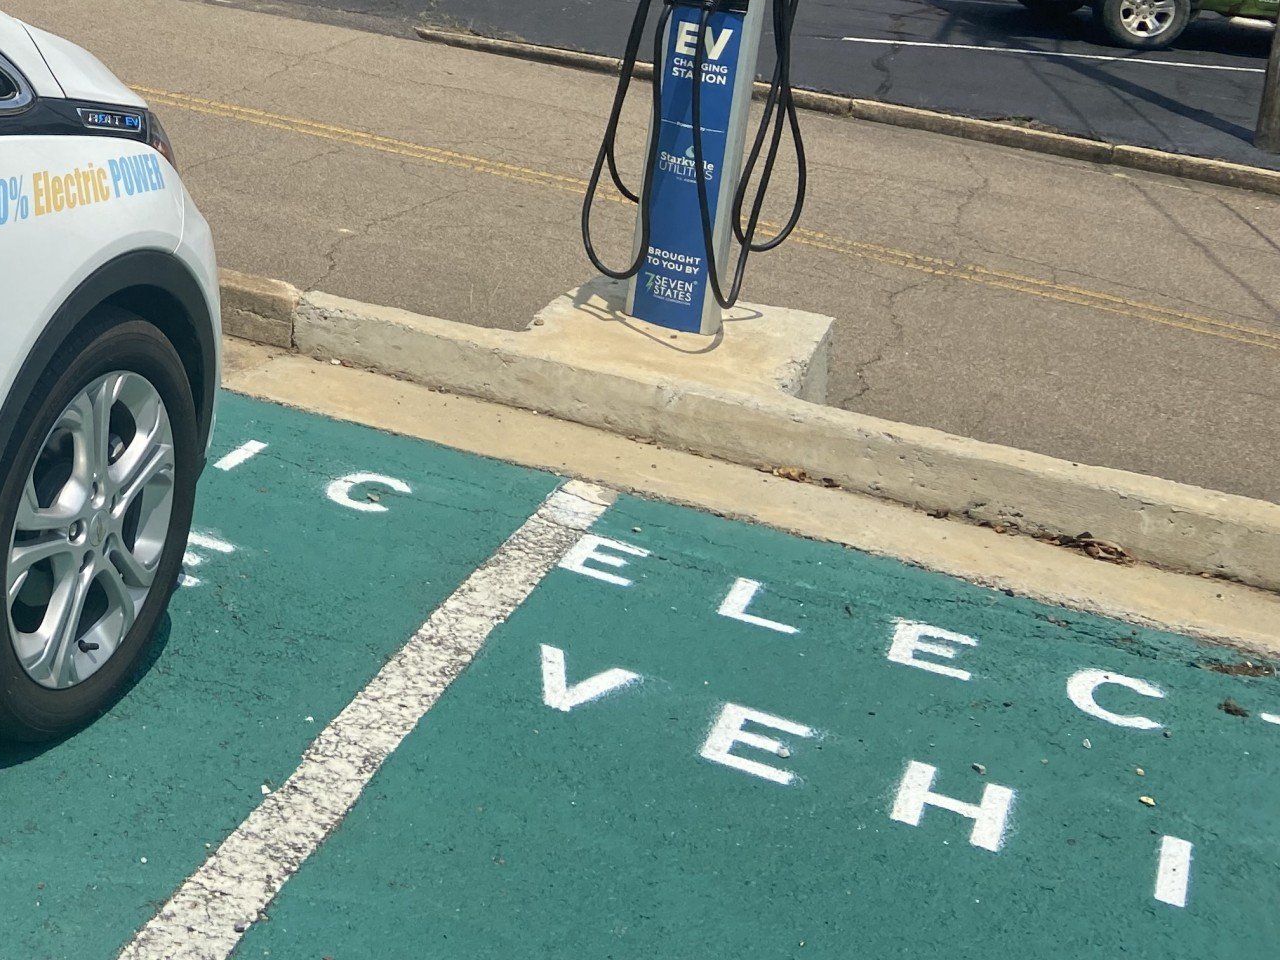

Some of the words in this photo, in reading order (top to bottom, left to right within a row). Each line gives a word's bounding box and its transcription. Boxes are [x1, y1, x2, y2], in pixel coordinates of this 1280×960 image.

[675, 21, 733, 61] EV
[673, 57, 728, 74] CHAGING
[671, 66, 727, 85] STAION
[125, 116, 138, 126] EV
[659, 160, 714, 181] UTILITIS
[660, 151, 714, 171] Starkvle
[32, 162, 110, 217] Electric
[108, 153, 166, 199] POWER
[647, 255, 660, 266] TO
[661, 260, 683, 271] YOU
[685, 266, 700, 275] BY
[648, 246, 701, 265] BROUGHT
[653, 285, 691, 302] STATES
[654, 275, 693, 293] SEVEN
